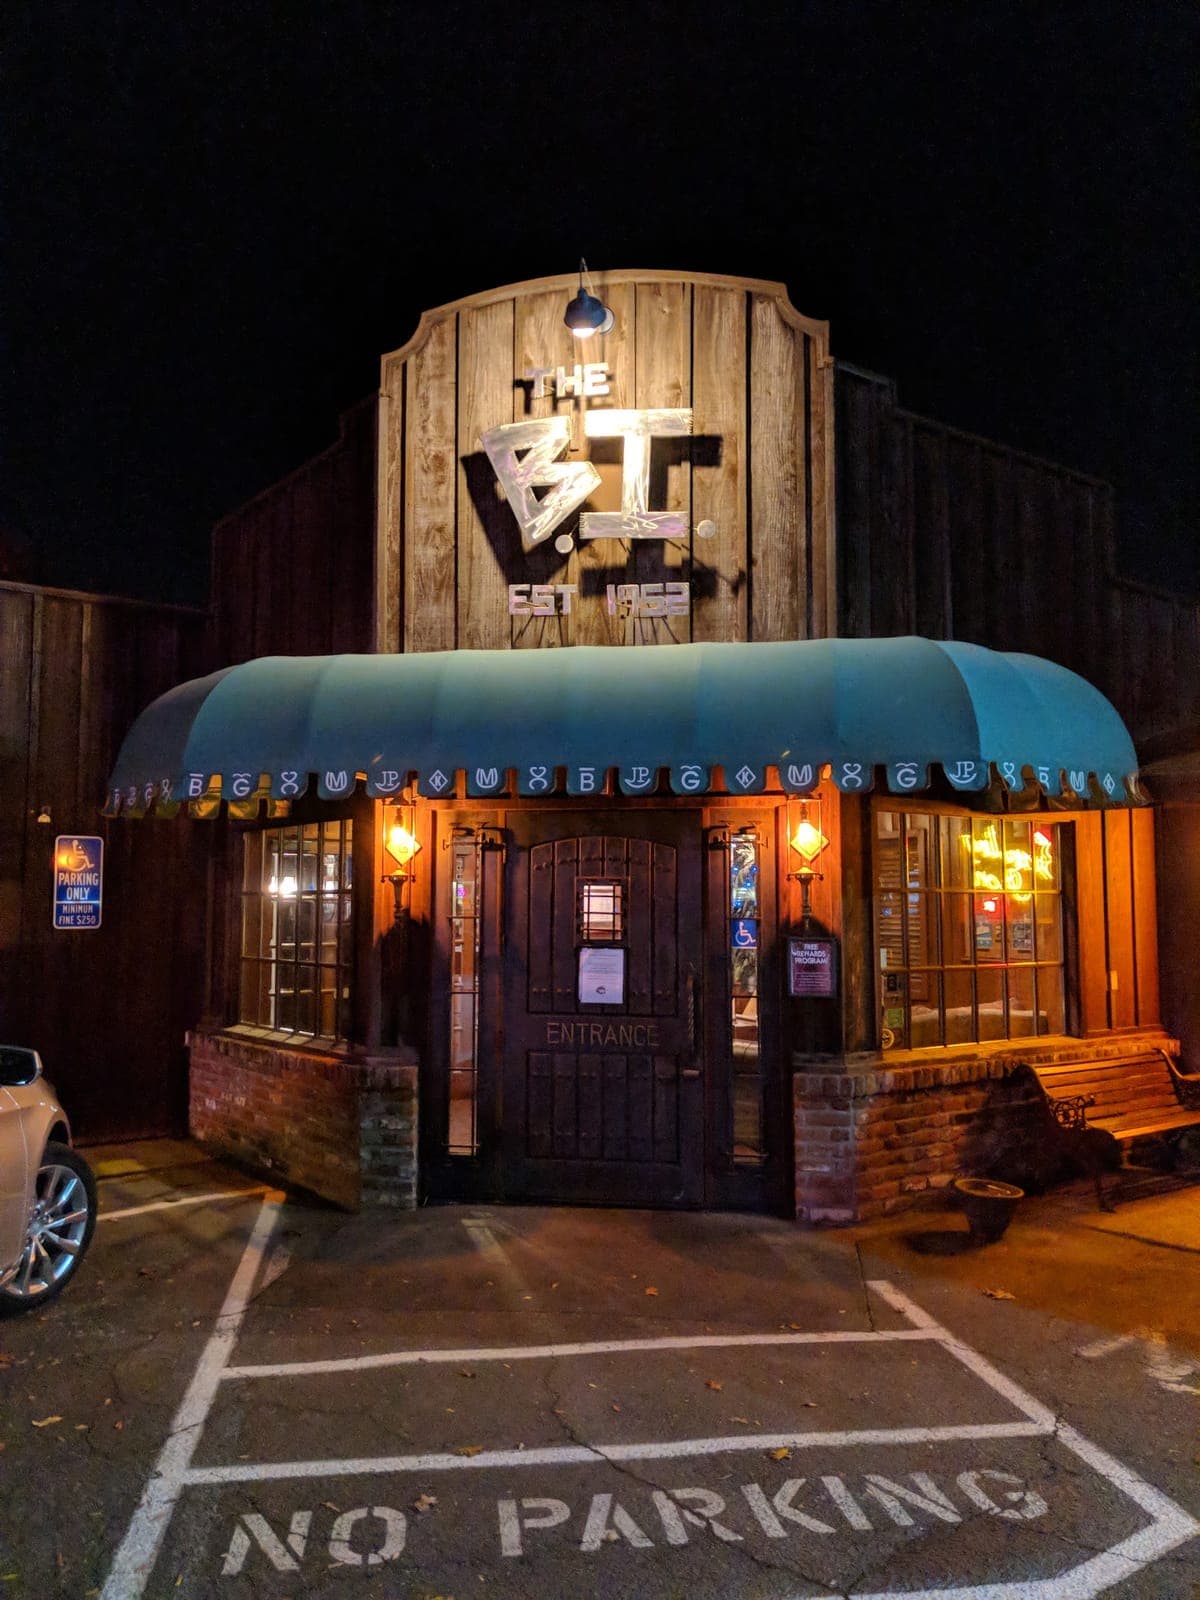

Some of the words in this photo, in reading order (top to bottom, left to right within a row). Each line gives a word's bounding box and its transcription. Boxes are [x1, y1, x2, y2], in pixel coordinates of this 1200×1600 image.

[524, 362, 610, 399] THE
[508, 583, 578, 616] EST
[606, 581, 691, 616] 1952
[58, 872, 99, 886] PARKING
[66, 886, 90, 900] ONLY
[62, 904, 93, 914] MINIMUM
[58, 915, 75, 925] FINE
[77, 915, 96, 925] $250
[546, 1022, 660, 1048] ENTRANCE
[220, 1505, 408, 1576] NO
[498, 1469, 1050, 1557] PARKING
